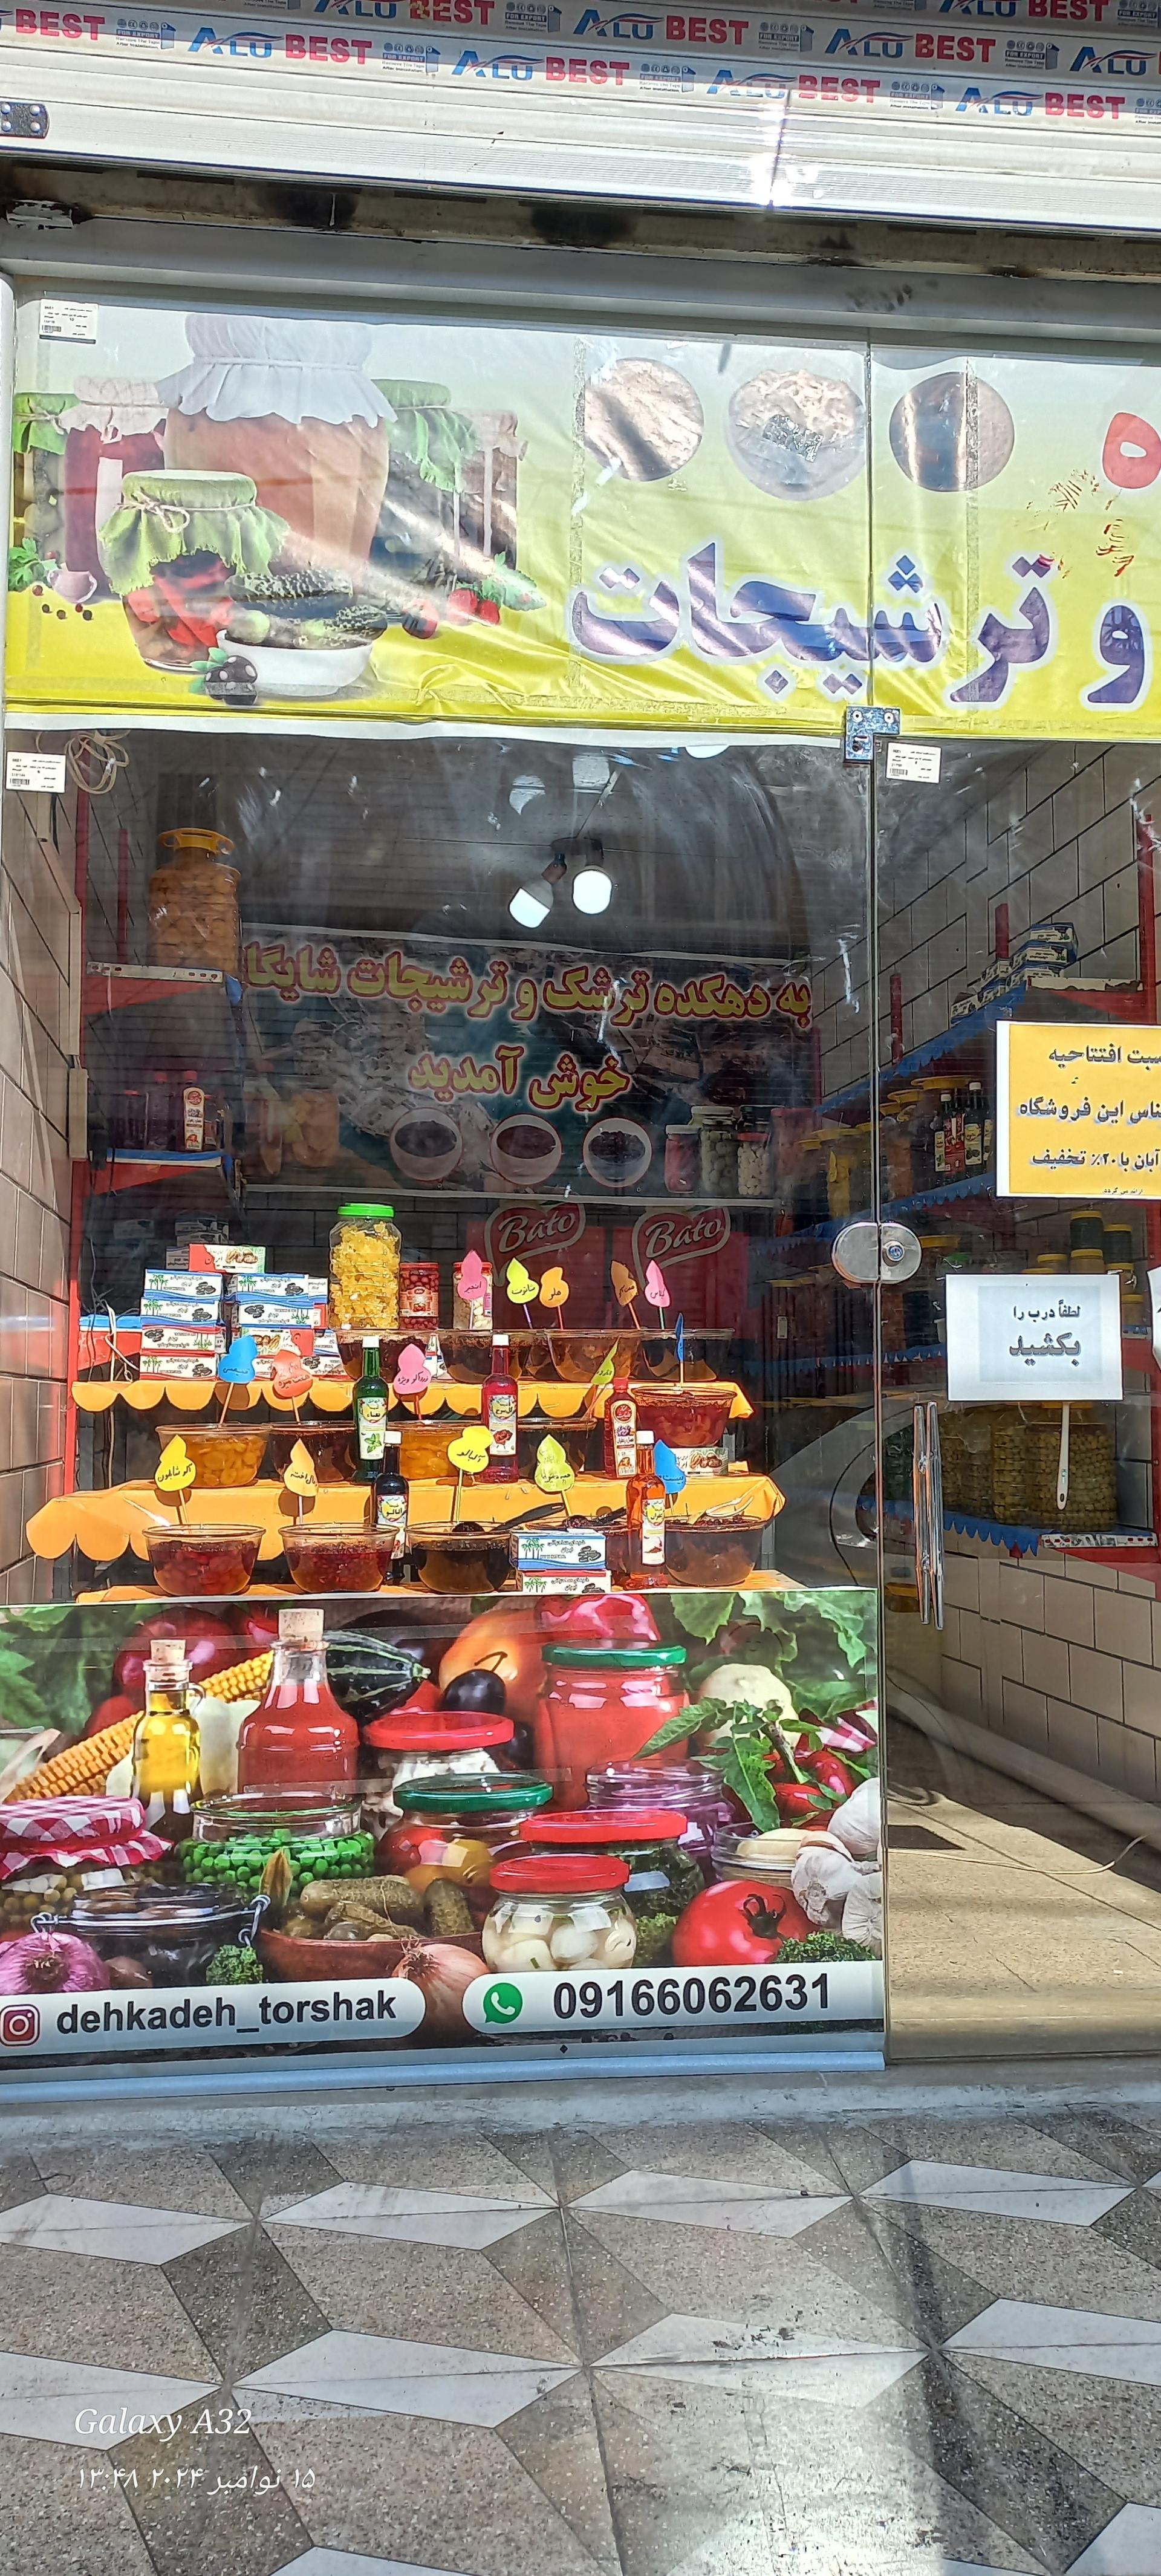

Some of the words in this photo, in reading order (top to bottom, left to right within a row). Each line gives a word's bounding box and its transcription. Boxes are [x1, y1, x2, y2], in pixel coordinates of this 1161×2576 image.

[16, 8, 105, 41] BEST
[410, 0, 495, 25] BEST
[573, 9, 653, 40] ALU
[666, 15, 749, 45] BEST
[1028, 0, 1109, 22] BEST
[187, 27, 272, 58] ALU
[285, 34, 372, 64] BEST
[825, 28, 903, 58] ALU
[915, 33, 996, 62] BEST
[1069, 46, 1146, 75] ALU
[452, 50, 533, 80] ALU
[546, 56, 629, 85] BEST
[799, 74, 880, 103] BEST
[955, 87, 1033, 117] ALU
[1046, 93, 1125, 119] BEST
[573, 541, 1052, 703] ترشیجات
[1087, 605, 1147, 703] و
[244, 940, 341, 1001] شایگا
[347, 951, 509, 1019] ترشیجات
[511, 978, 537, 1021] و
[544, 965, 651, 1026] ترشک
[654, 974, 771, 1018] دهکده
[776, 980, 811, 1028] به
[1049, 1043, 1122, 1068] افتتاحیه
[408, 1044, 524, 1102] آمدید
[529, 1051, 630, 1113] خوش
[1019, 1096, 1091, 1121] فروشگاه
[1097, 1099, 1124, 1124] این
[1032, 1148, 1085, 1170] تخفیف
[1120, 1151, 1130, 1172] با
[1134, 1148, 1159, 1172] آبان
[498, 1211, 576, 1253] Bato
[645, 1217, 721, 1258] Bato
[464, 1281, 482, 1294] انجیر
[1013, 1305, 1024, 1321] را
[1028, 1306, 1055, 1322] درب
[1058, 1299, 1081, 1318] لطفاً
[1009, 1332, 1081, 1367] بکشید
[457, 1449, 486, 1463] آلبالو
[56, 1989, 397, 2035] dehkadeh_torshak
[553, 1973, 829, 2020] 09166062631
